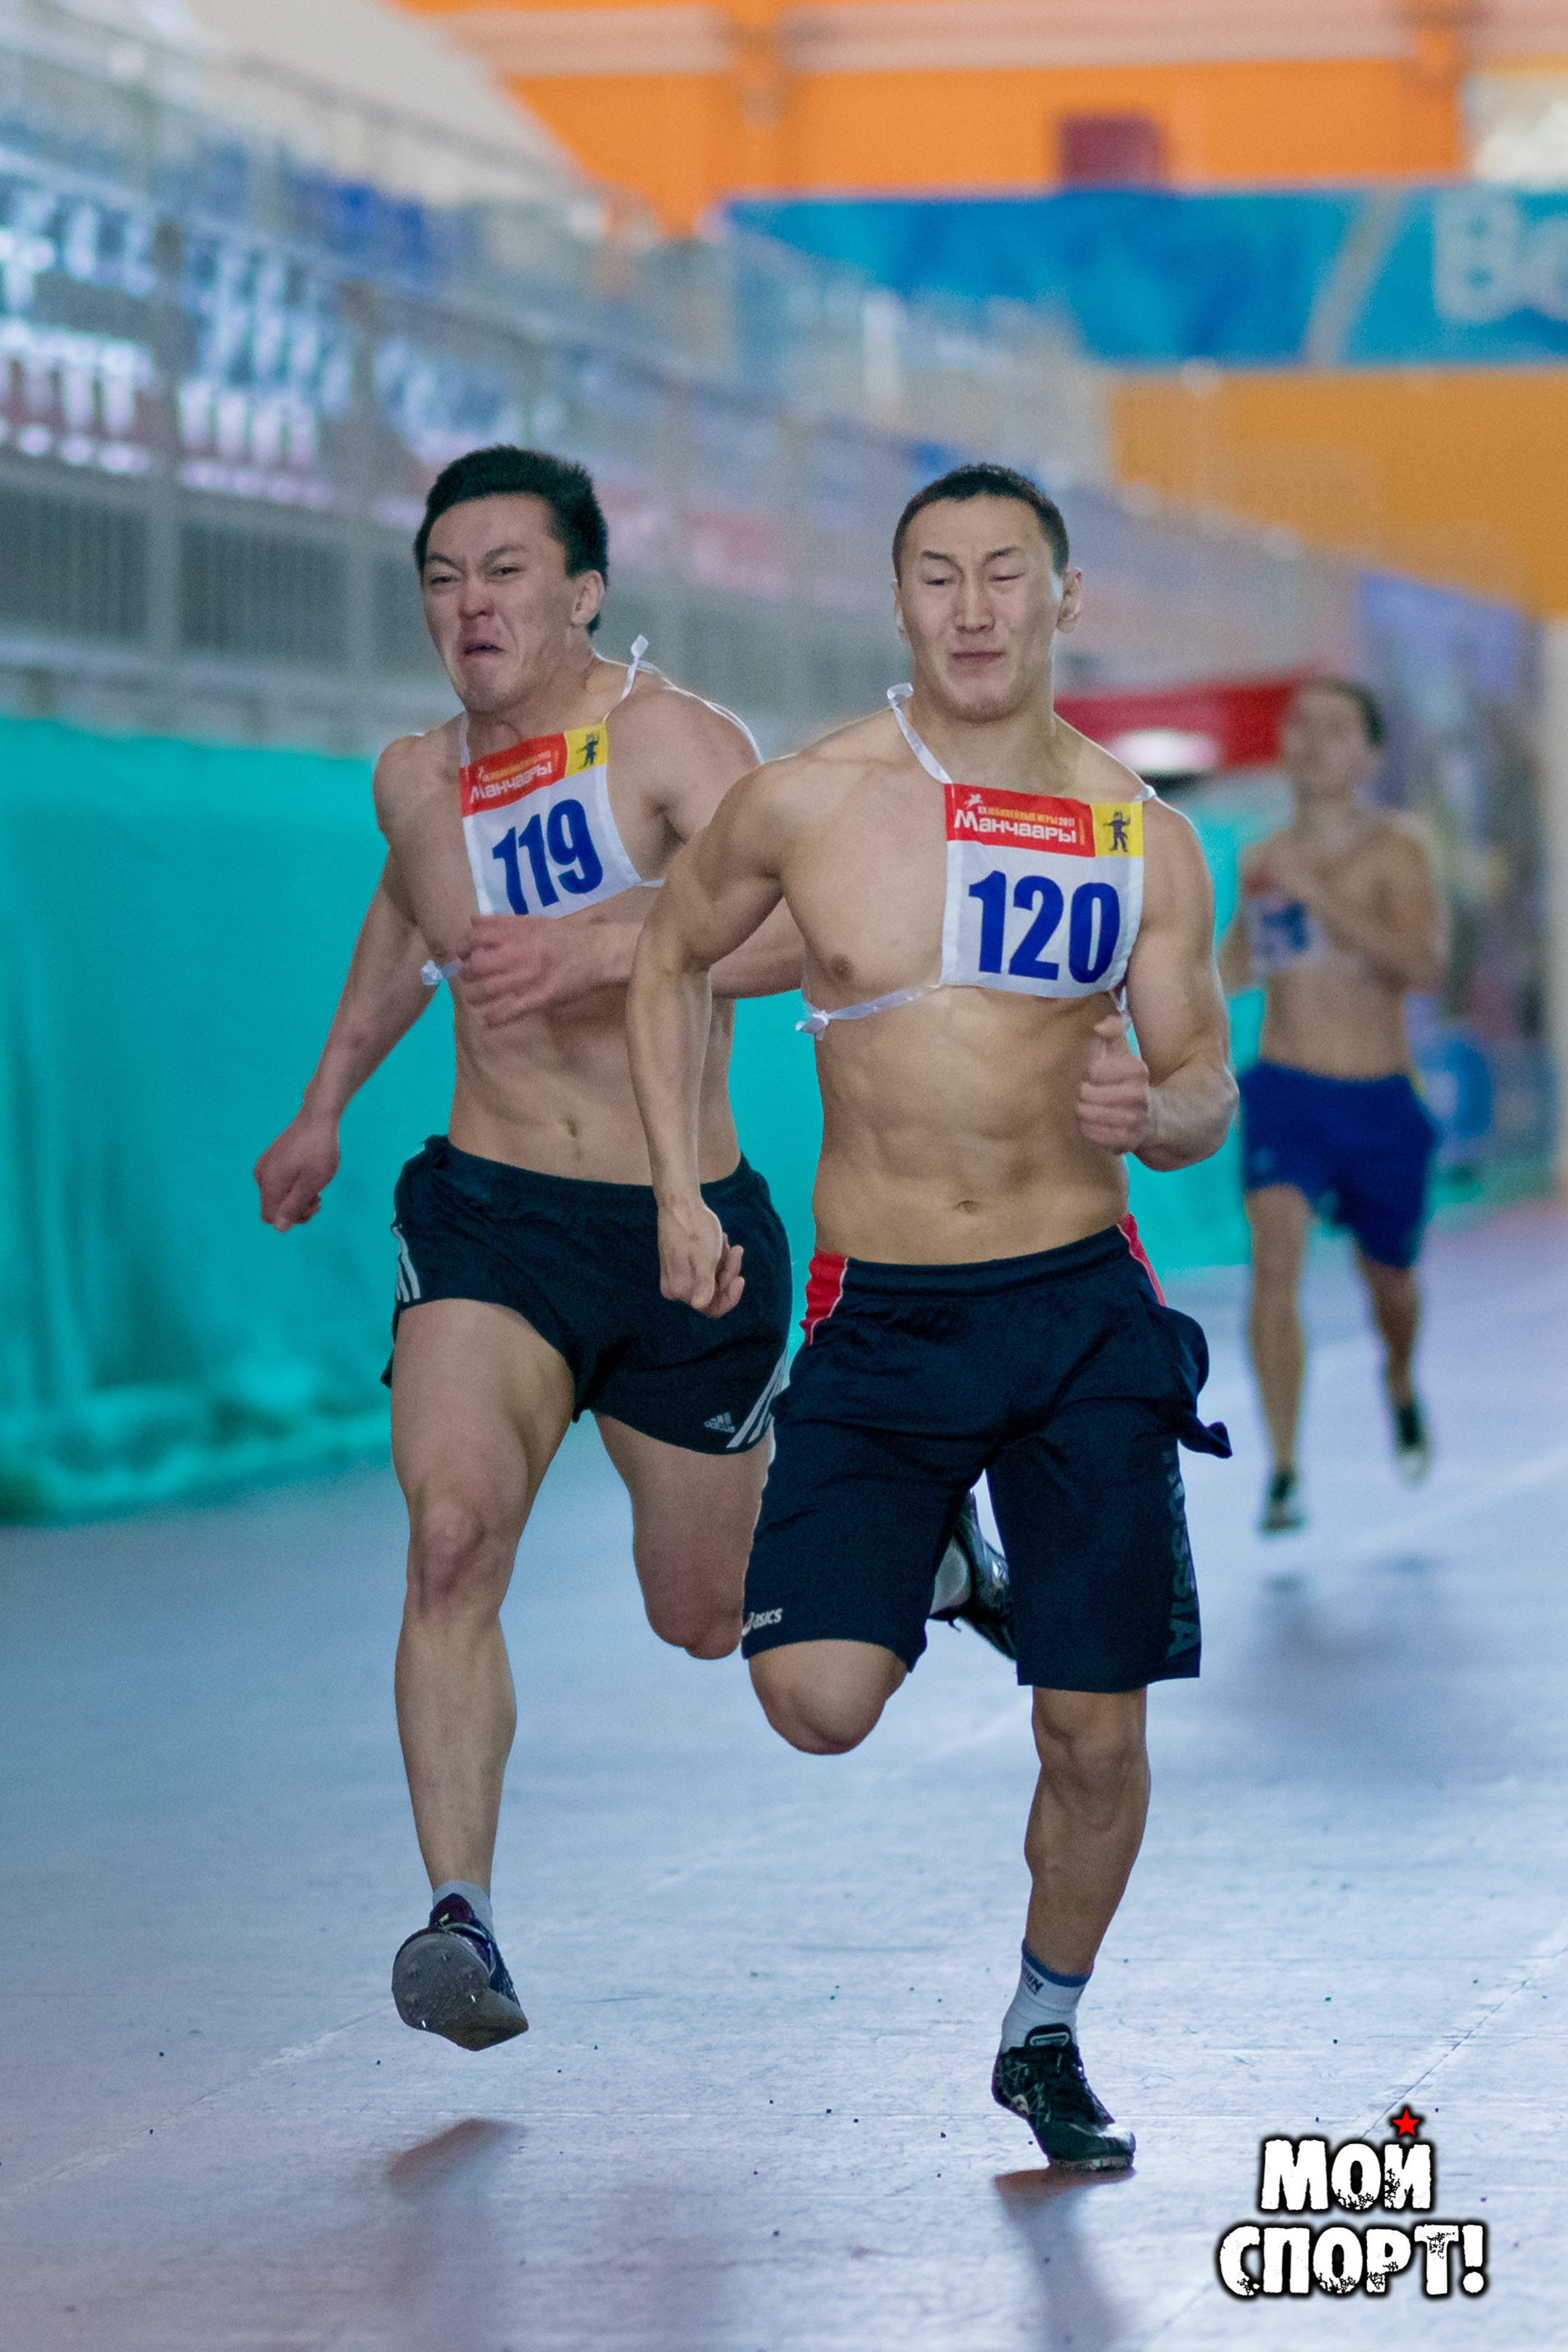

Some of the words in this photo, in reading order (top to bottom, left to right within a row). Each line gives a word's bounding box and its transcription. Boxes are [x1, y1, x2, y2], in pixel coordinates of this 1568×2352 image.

[491, 798, 604, 915] 119
[953, 809, 1077, 844] Манчаары
[968, 870, 1121, 984] 120
